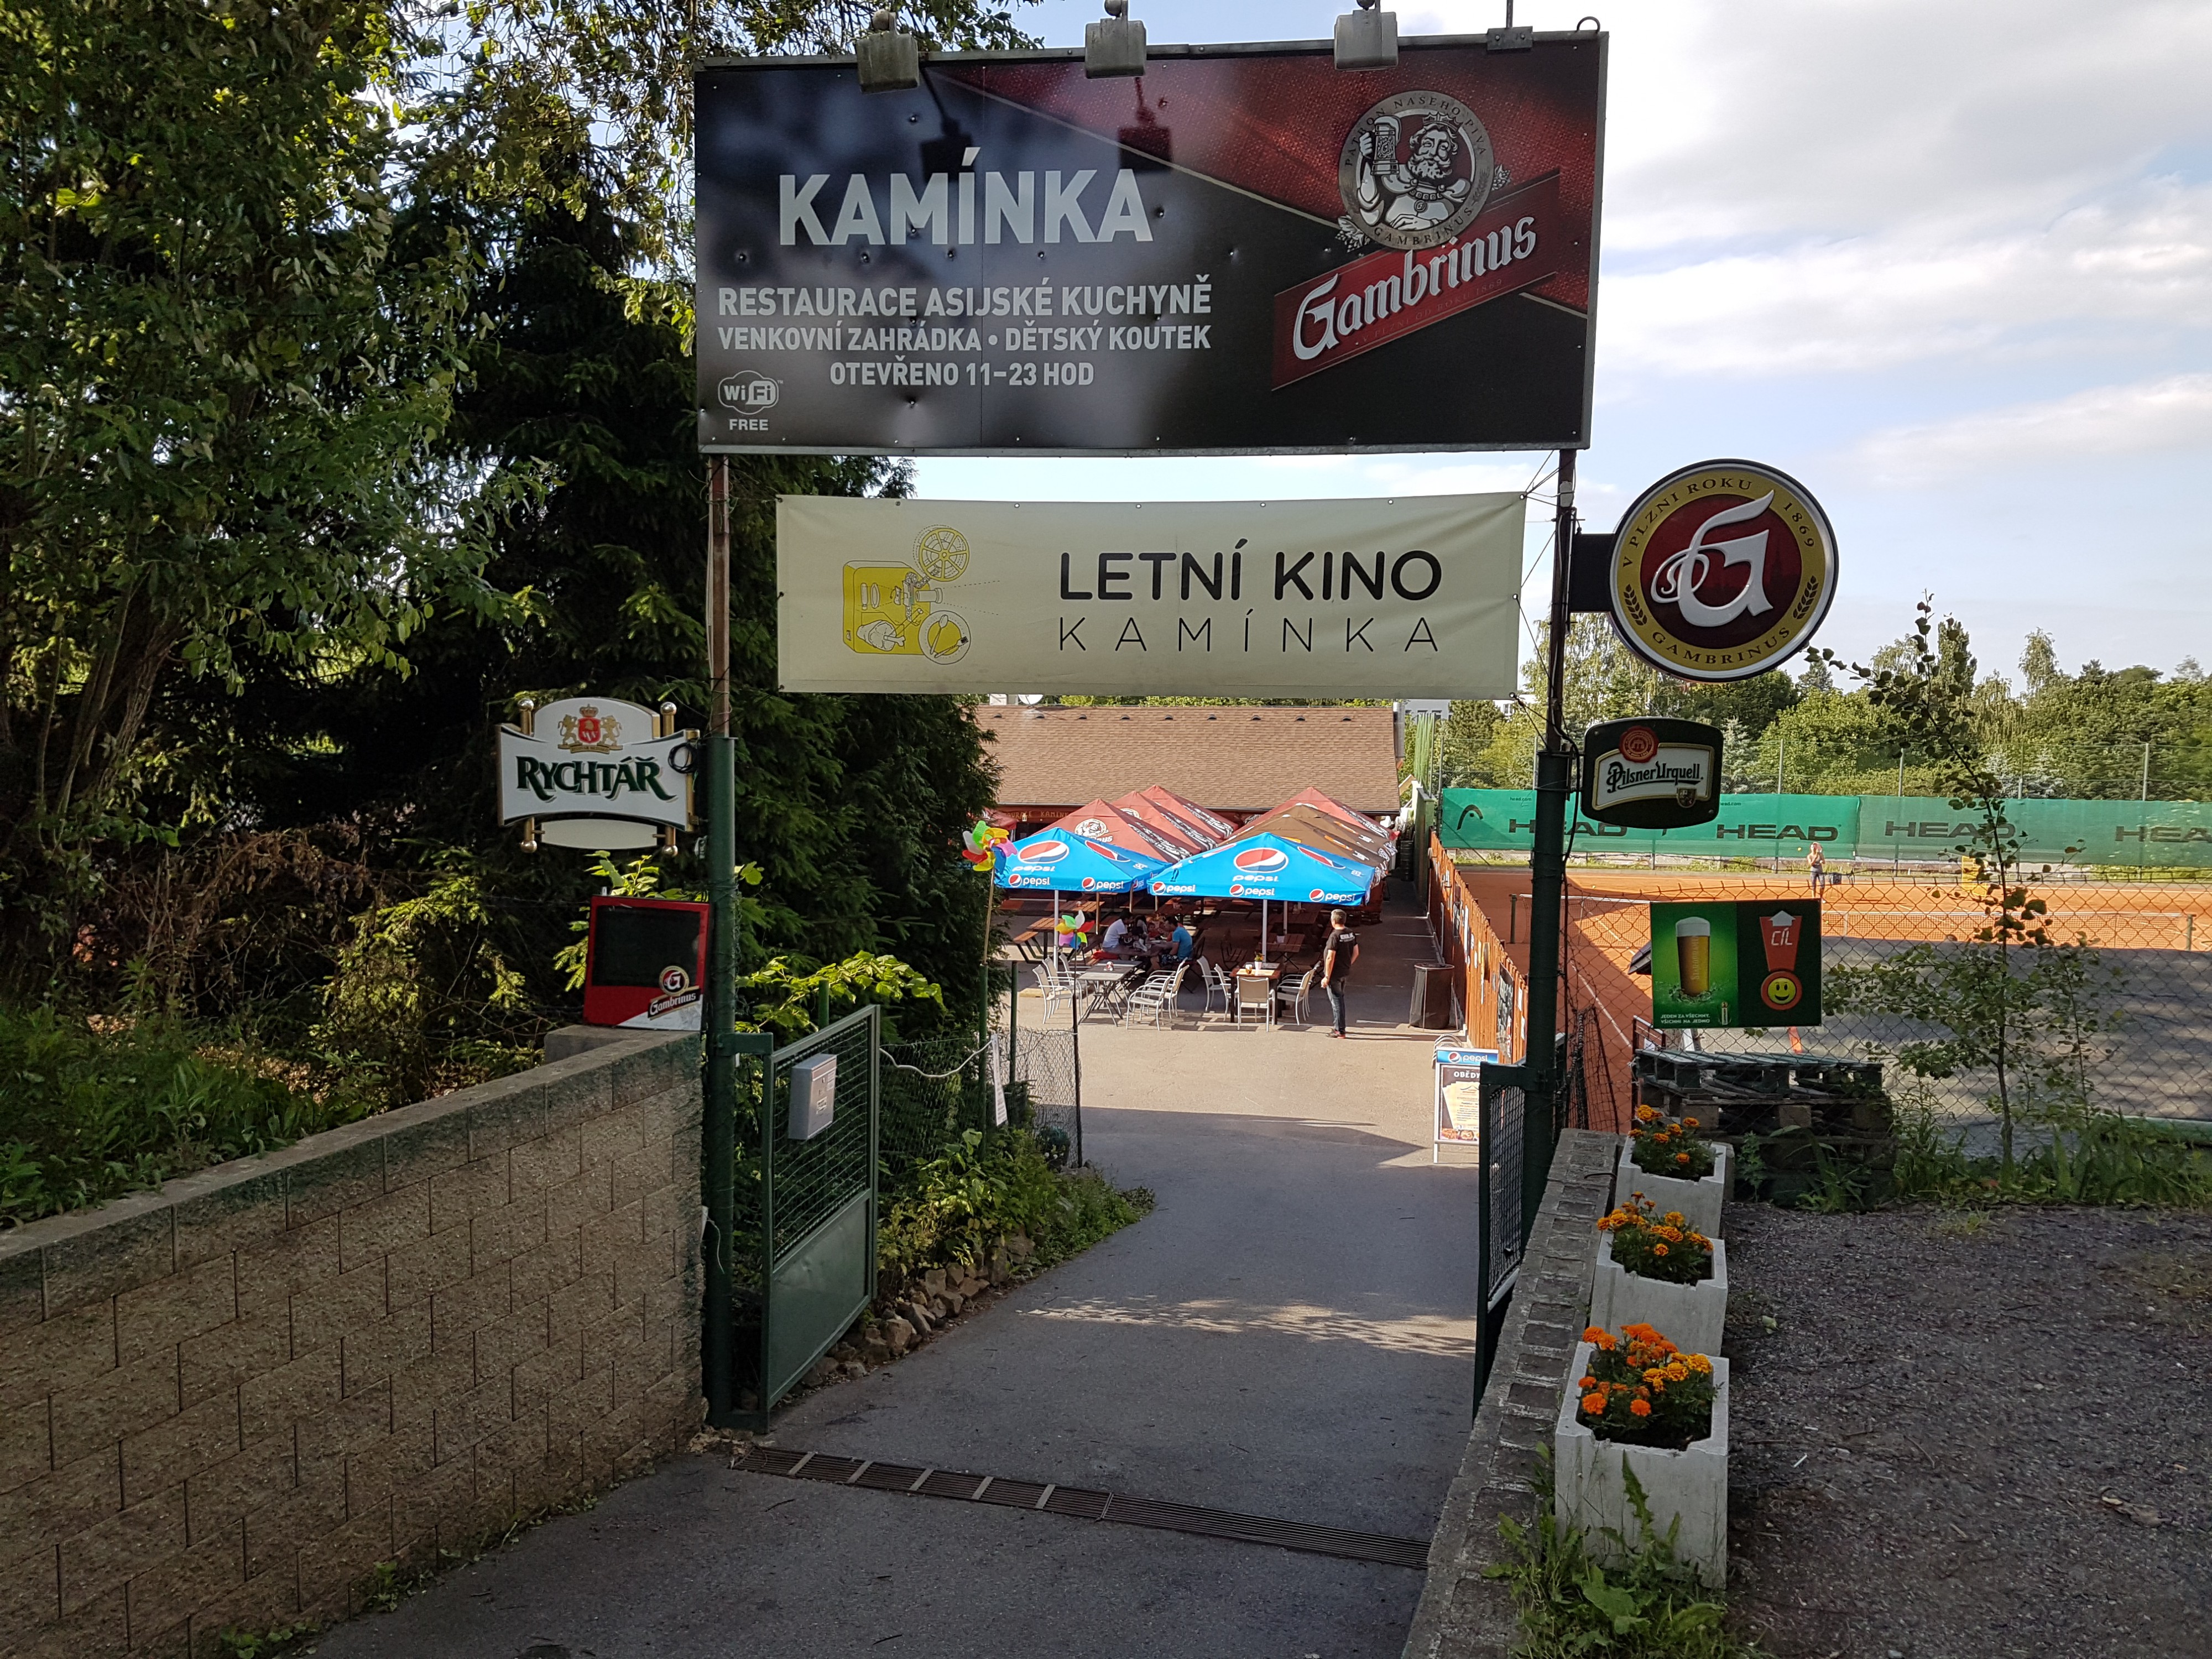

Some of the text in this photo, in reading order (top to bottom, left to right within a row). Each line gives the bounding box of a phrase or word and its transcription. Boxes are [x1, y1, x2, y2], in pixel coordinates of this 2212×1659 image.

[1465, 118, 1487, 155] PIVA
[780, 147, 1154, 245] KAMÍNKA
[1374, 207, 1473, 245] GAMBRINUS
[718, 274, 1212, 316] RESTAURACE ASIJSKÉ KUCHYNĚ
[1293, 216, 1536, 361] Gambrinus
[717, 319, 1212, 352] VENKOVNÍ ZAHRÁDKA DĚTSKÝ KOUTEK
[830, 354, 959, 386] OTEVŘENO
[1044, 362, 1094, 386] HOD
[729, 419, 769, 431] FREE
[1623, 478, 1815, 568] V PLZNI ROKU 1869
[1060, 538, 1442, 601] LETNÍ KINO
[1060, 608, 1438, 653] KAMÍNKA
[1652, 627, 1791, 664] GAMBRINUS
[515, 755, 678, 802] RYCHTÁŘ
[1606, 761, 1657, 794] Pilsner
[1509, 819, 1627, 836] HAD
[1717, 824, 1839, 842] HEAD
[1885, 821, 2016, 839] HEAD
[1022, 877, 1050, 887] pepsi
[1095, 880, 1124, 891] pepsi
[1166, 884, 1355, 903] pepsi pepsi pepsi
[1771, 927, 1793, 946] CÍL
[649, 992, 697, 1016] Gambrinus
